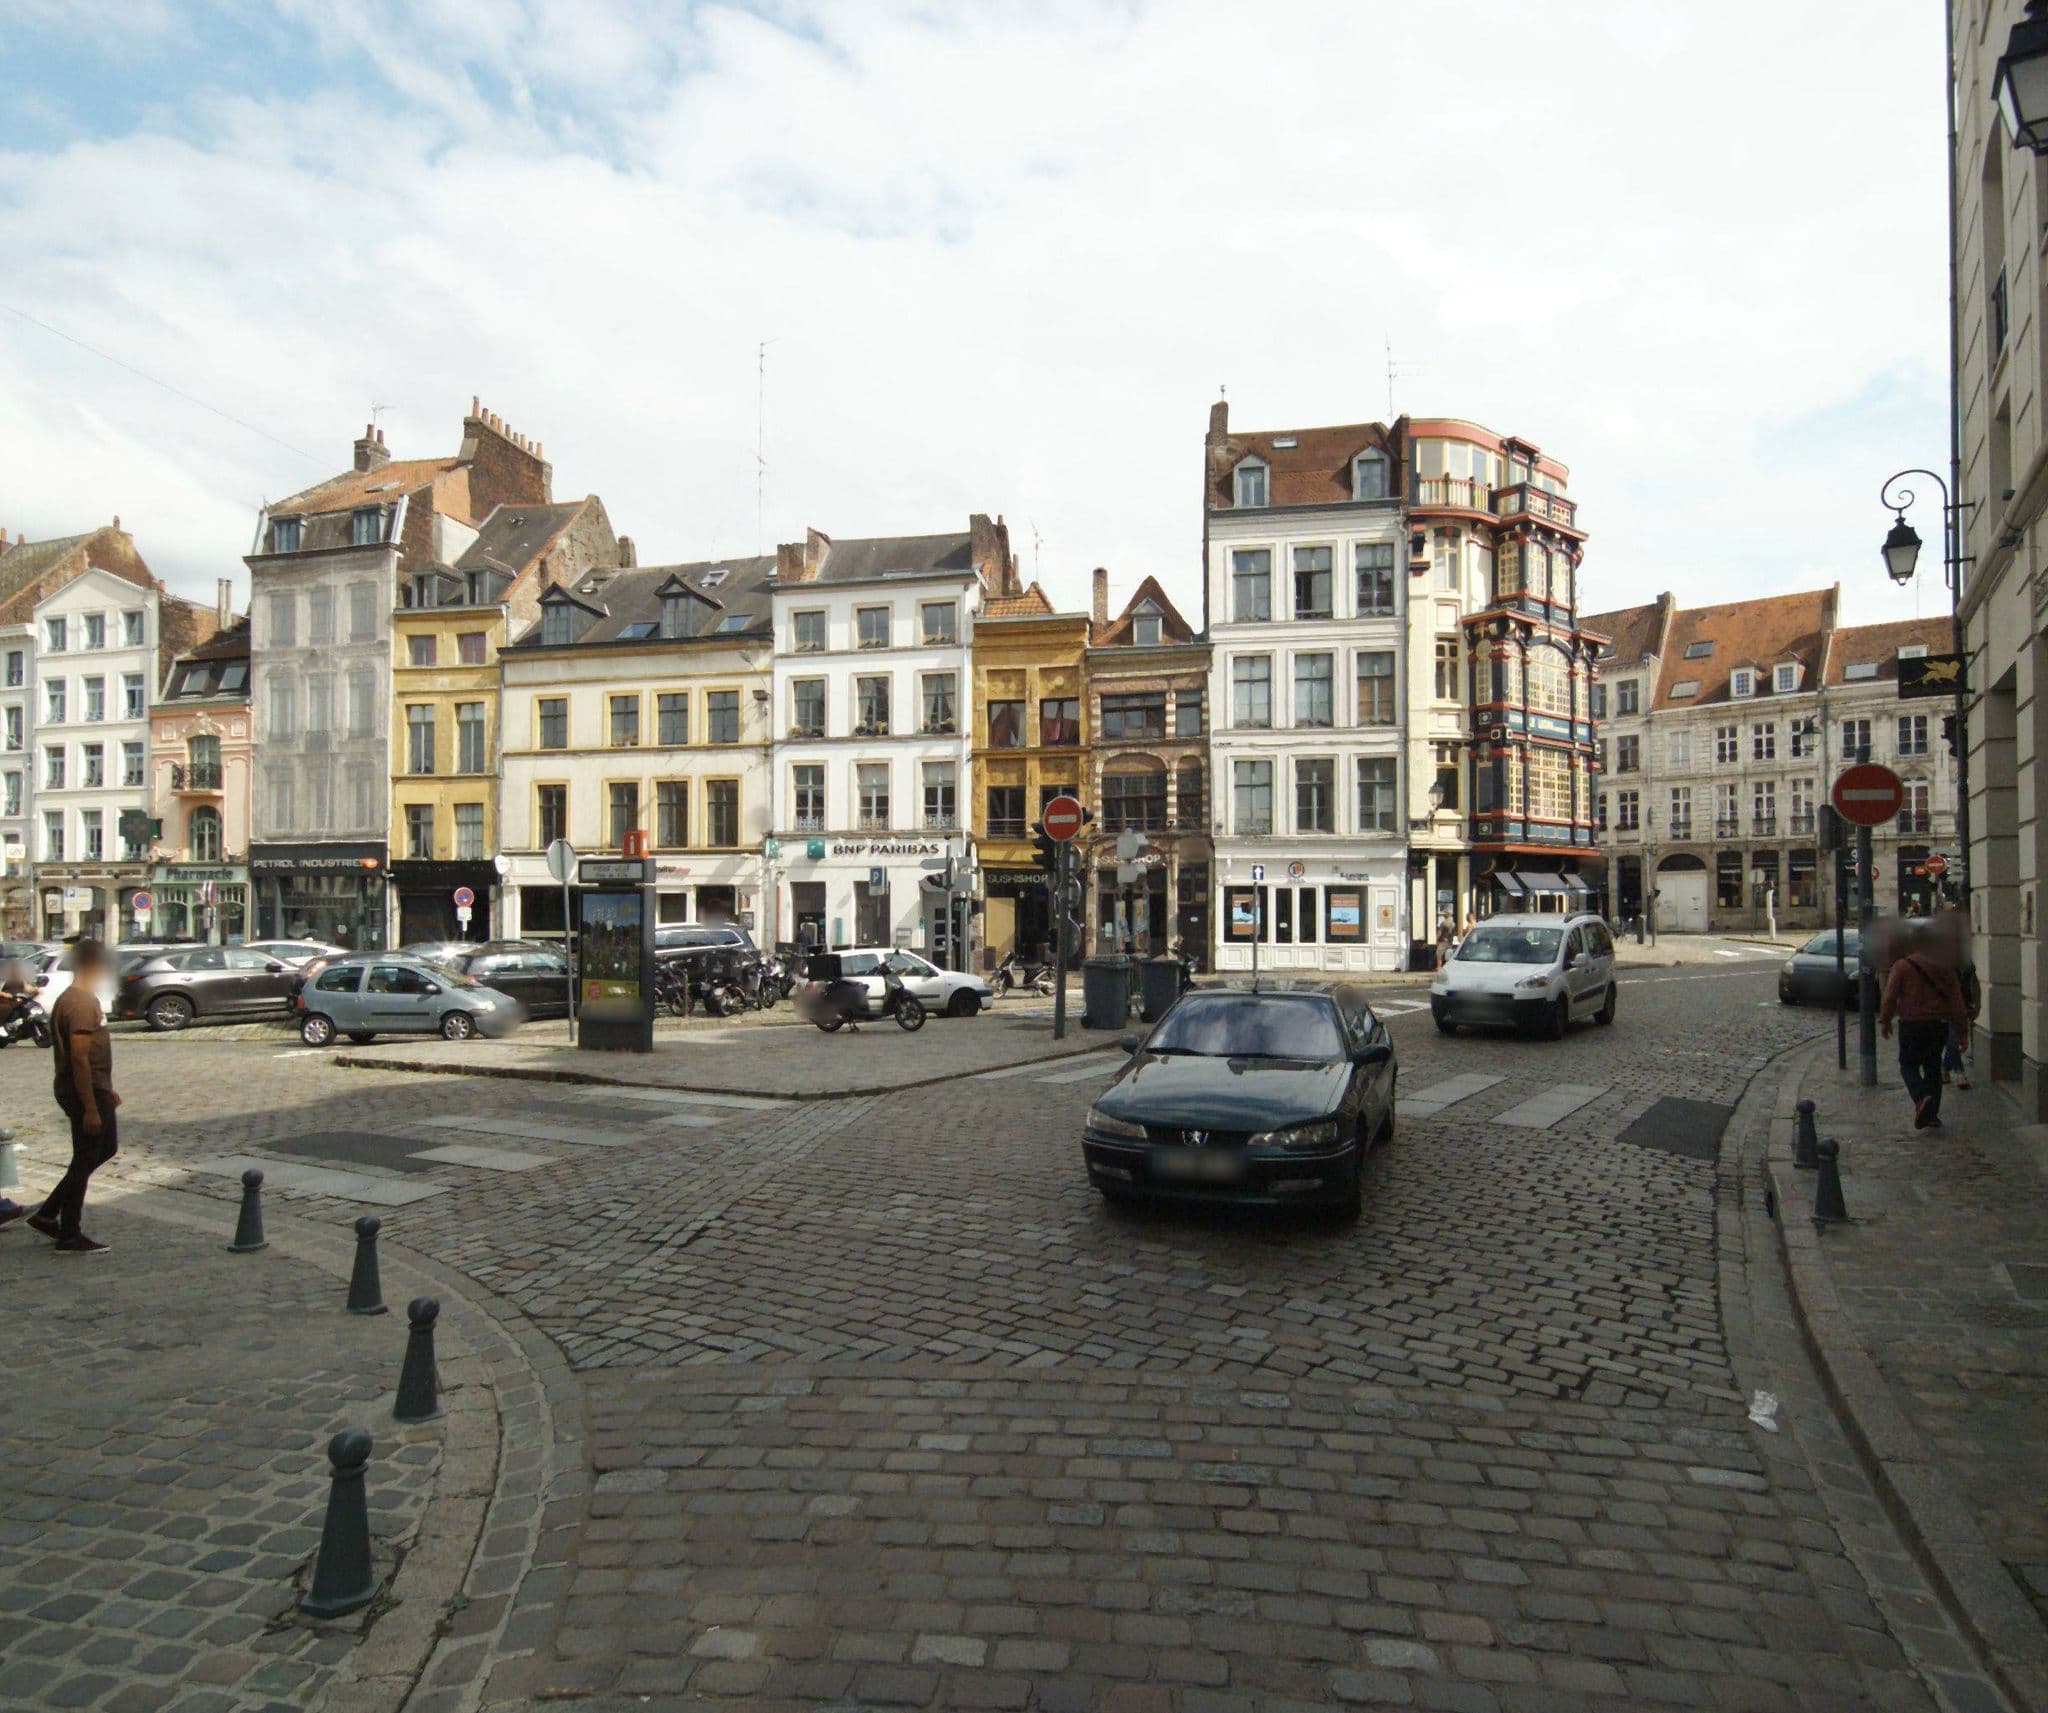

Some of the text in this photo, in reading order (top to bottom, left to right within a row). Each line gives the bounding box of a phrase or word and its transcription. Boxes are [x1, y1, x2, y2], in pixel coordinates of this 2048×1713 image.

[833, 843, 940, 855] BNP PARIBAS
[253, 859, 296, 868] PETROL
[166, 867, 234, 880] Pharmacie
